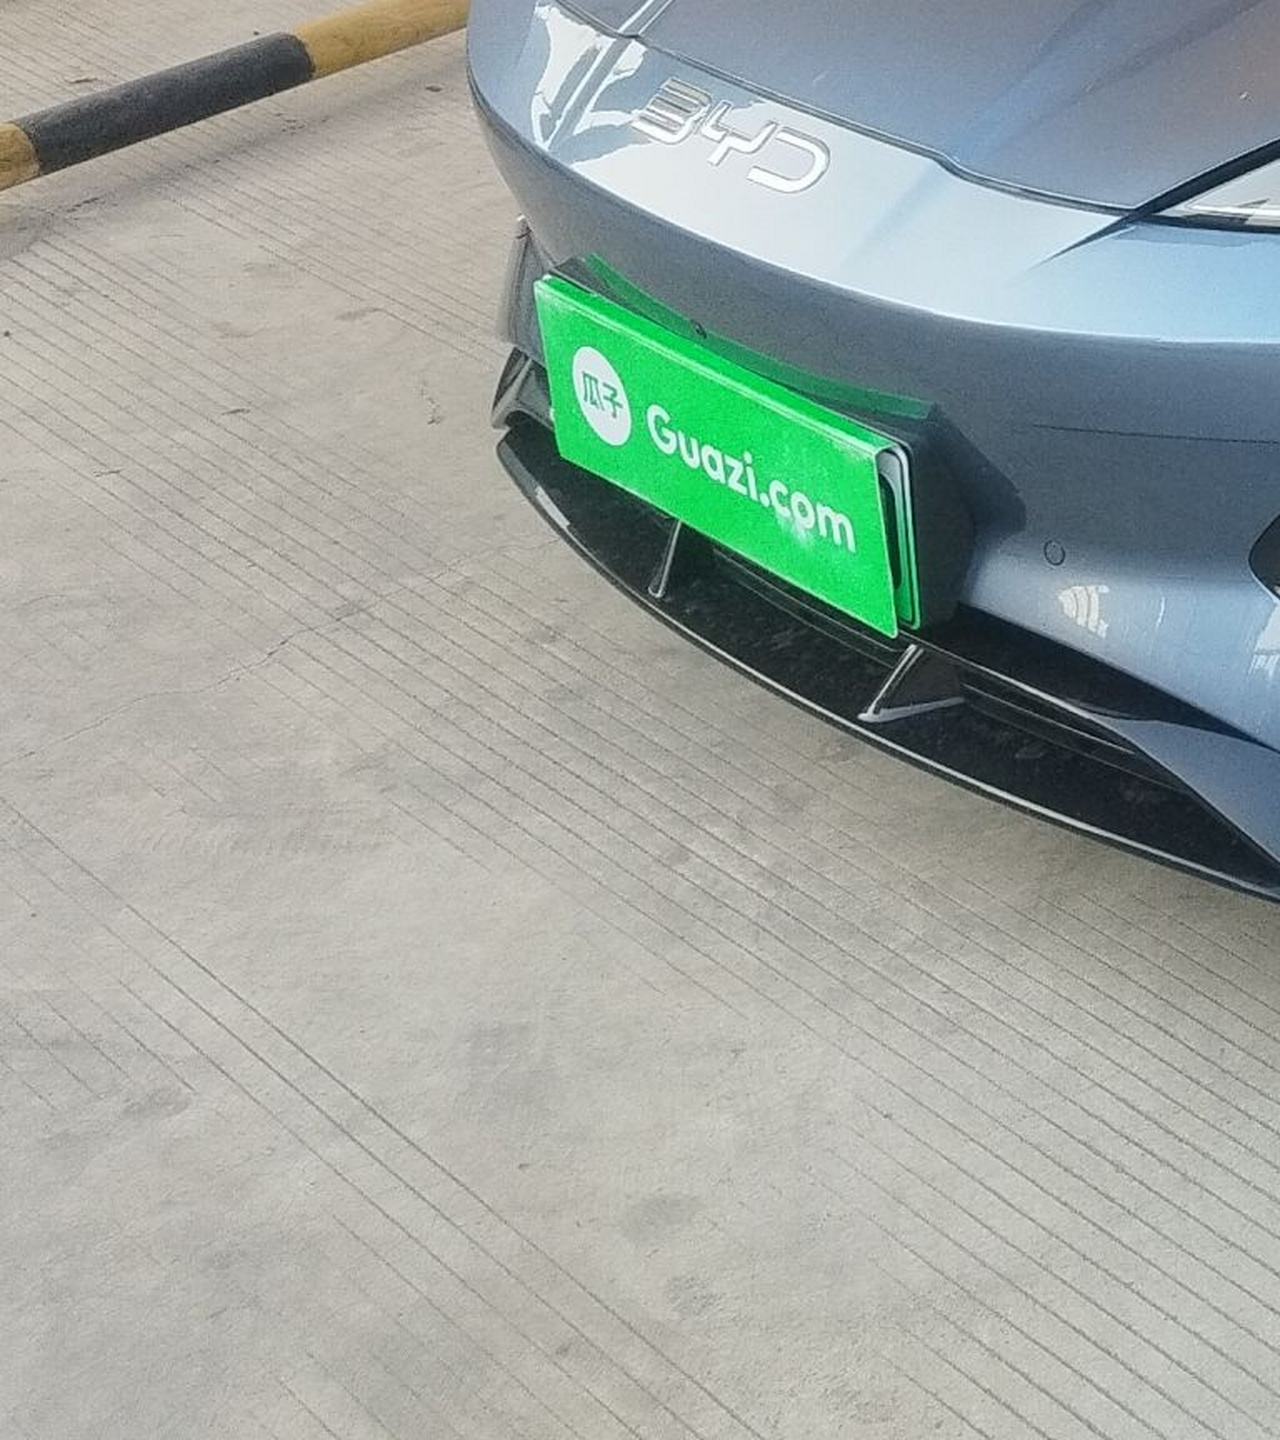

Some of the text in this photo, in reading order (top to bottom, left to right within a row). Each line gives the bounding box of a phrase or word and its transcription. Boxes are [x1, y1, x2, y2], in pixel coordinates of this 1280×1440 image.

[631, 76, 832, 194] BYD
[581, 370, 625, 419] 瓜子
[646, 404, 857, 554] Guazi.com
